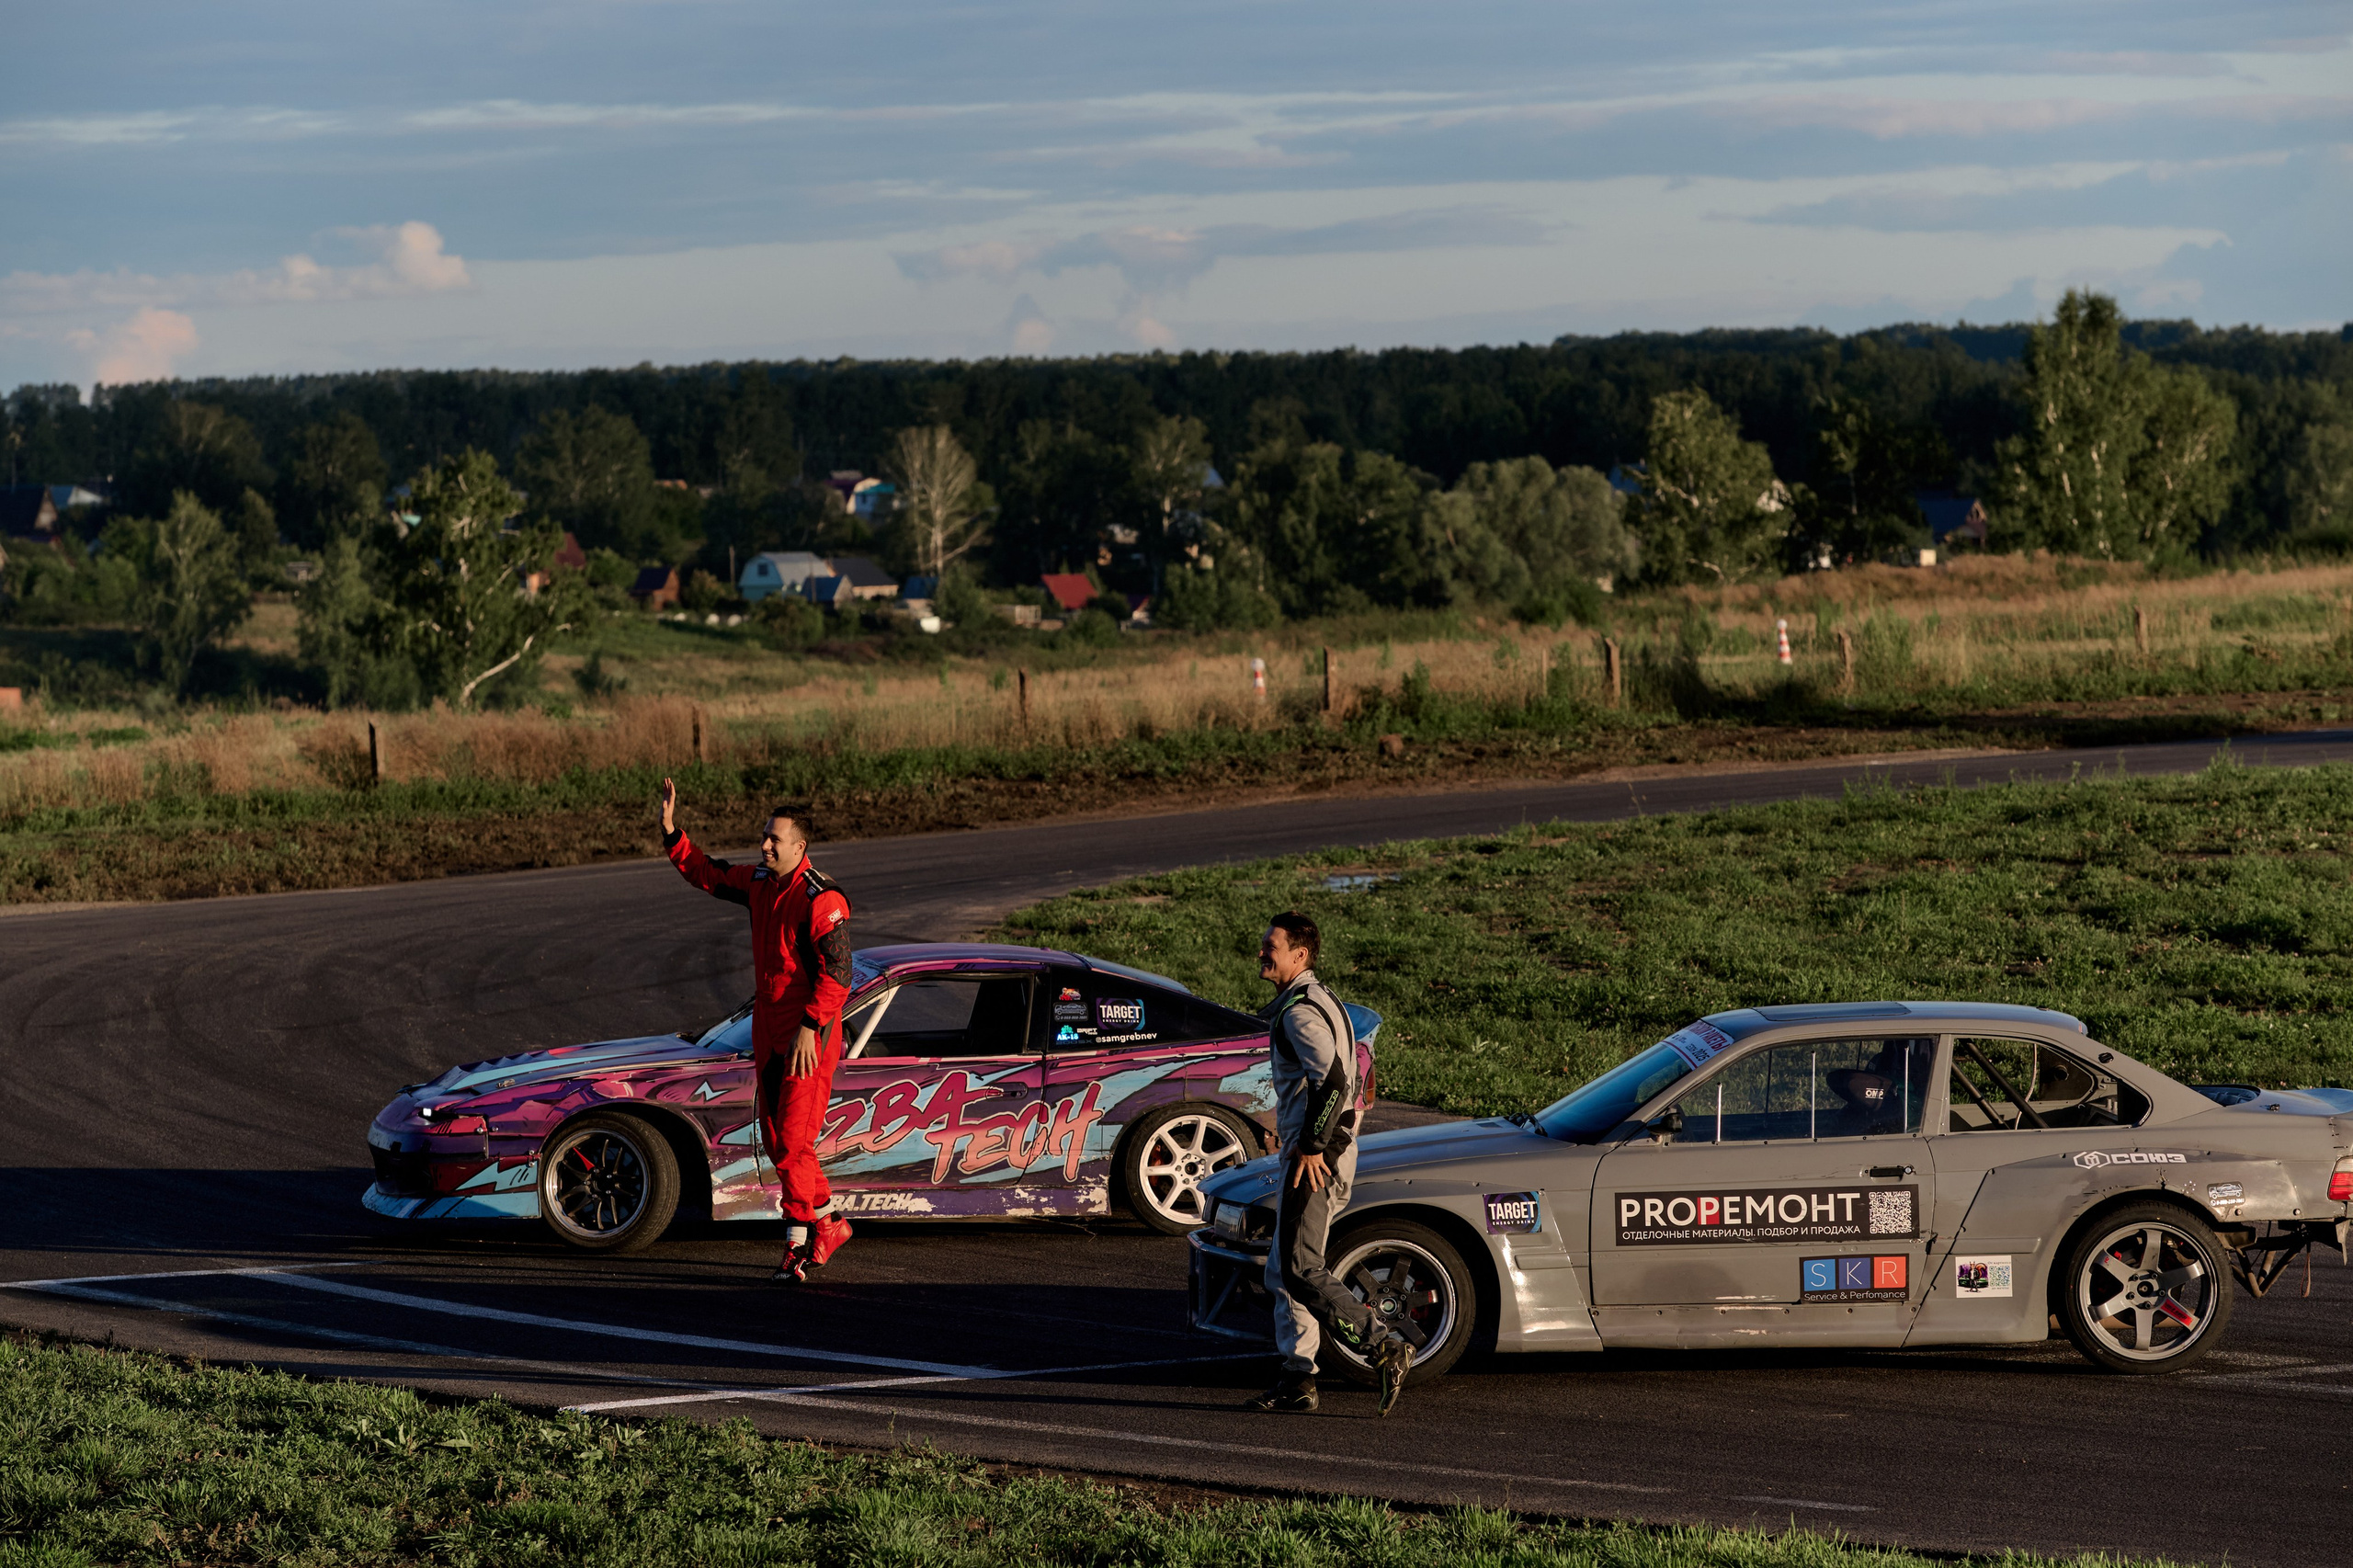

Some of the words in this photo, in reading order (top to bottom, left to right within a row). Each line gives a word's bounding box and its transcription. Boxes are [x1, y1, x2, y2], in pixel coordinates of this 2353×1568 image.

[828, 909, 843, 923] OMP
[1099, 1005, 1142, 1019] TARGET
[1865, 1088, 1884, 1098] OMP
[1487, 1200, 1538, 1220] TARGET
[1622, 1230, 1690, 1241] ОТДЕЛОЧНЫЕ
[1756, 1227, 1799, 1237] ПОДБОР
[1801, 1227, 1808, 1235] И
[1810, 1225, 1861, 1235] ПРОДАЖА
[1803, 1292, 1838, 1301] Service
[1839, 1291, 1848, 1300] &
[1849, 1290, 1906, 1300] Perfomance
